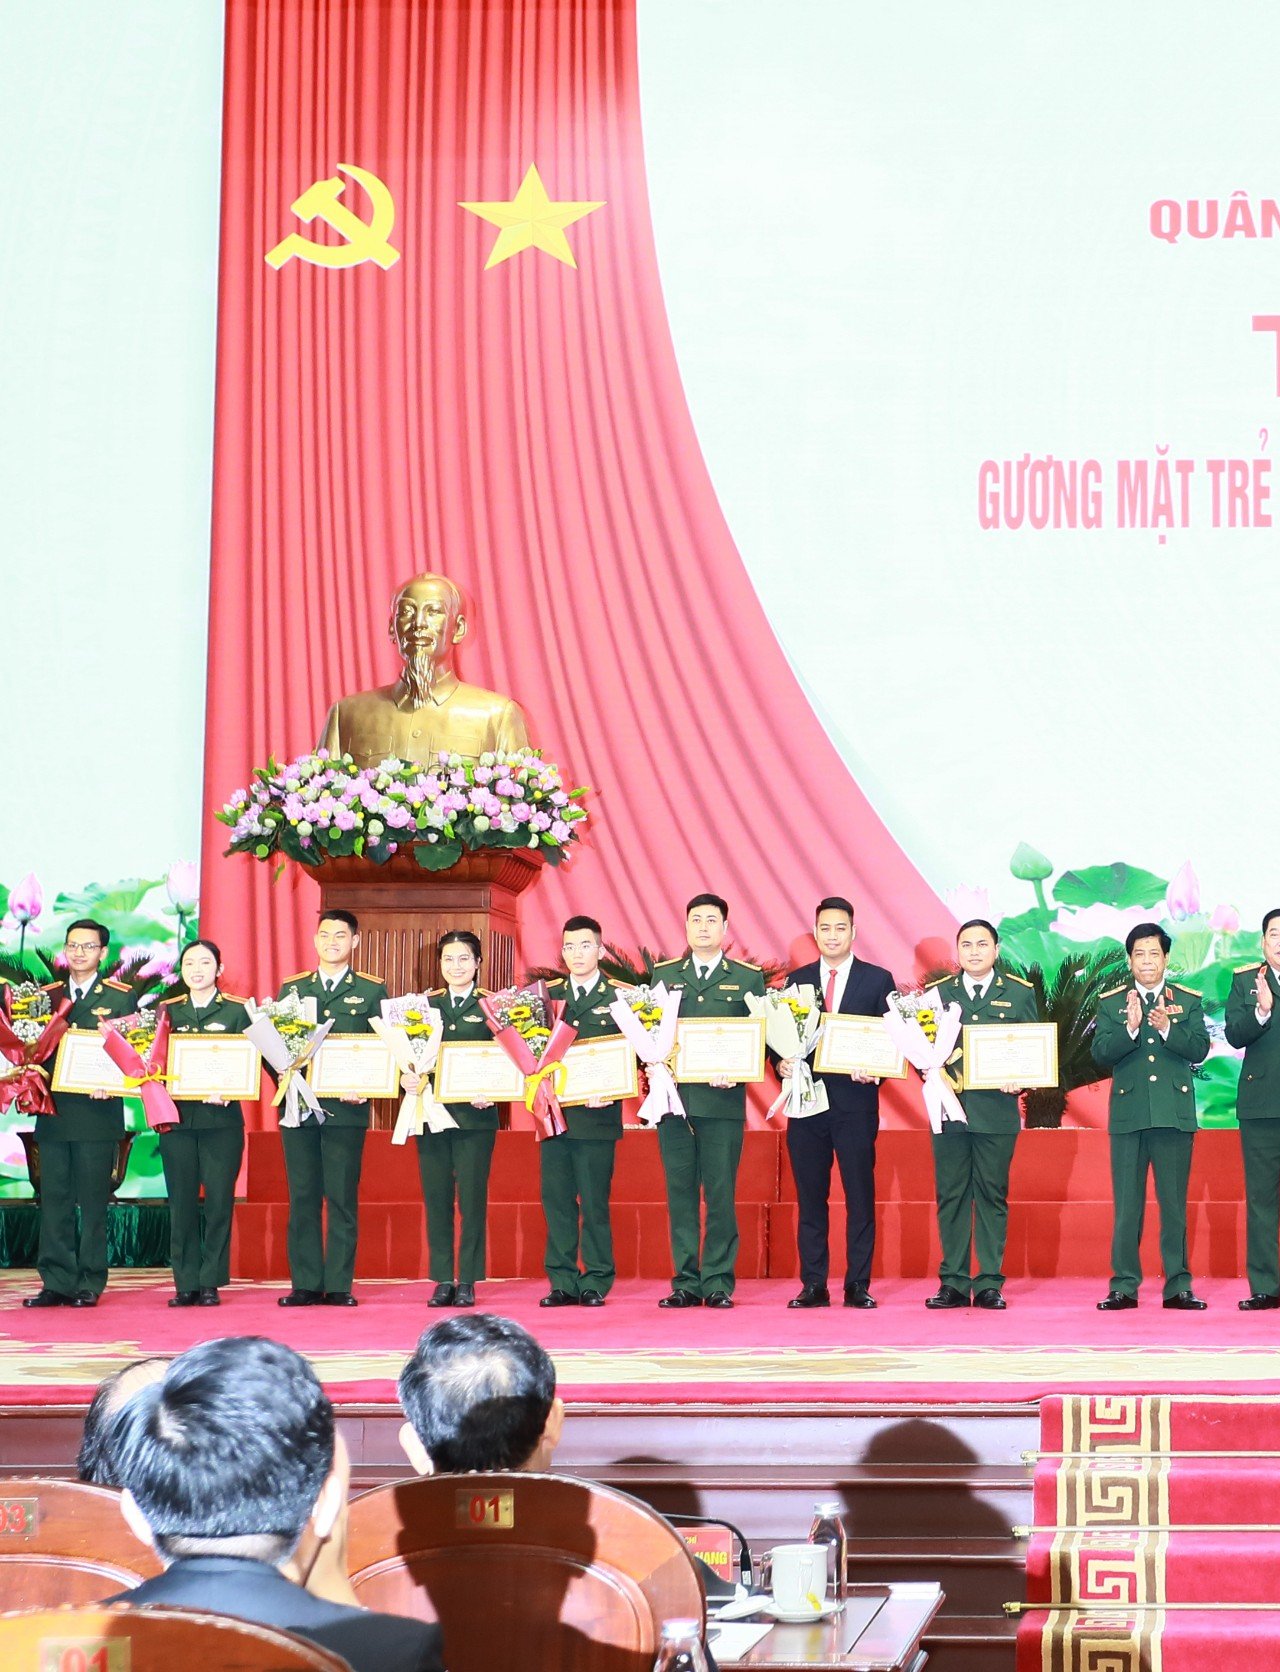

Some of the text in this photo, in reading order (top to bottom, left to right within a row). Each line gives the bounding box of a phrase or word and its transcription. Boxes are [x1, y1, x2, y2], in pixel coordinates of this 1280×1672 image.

[978, 453, 1103, 531] GƯƠNG
[1117, 443, 1195, 545] MẶT
[1206, 427, 1273, 528] TRẺ
[469, 1494, 500, 1523] 01
[59, 1645, 109, 1672] 01
